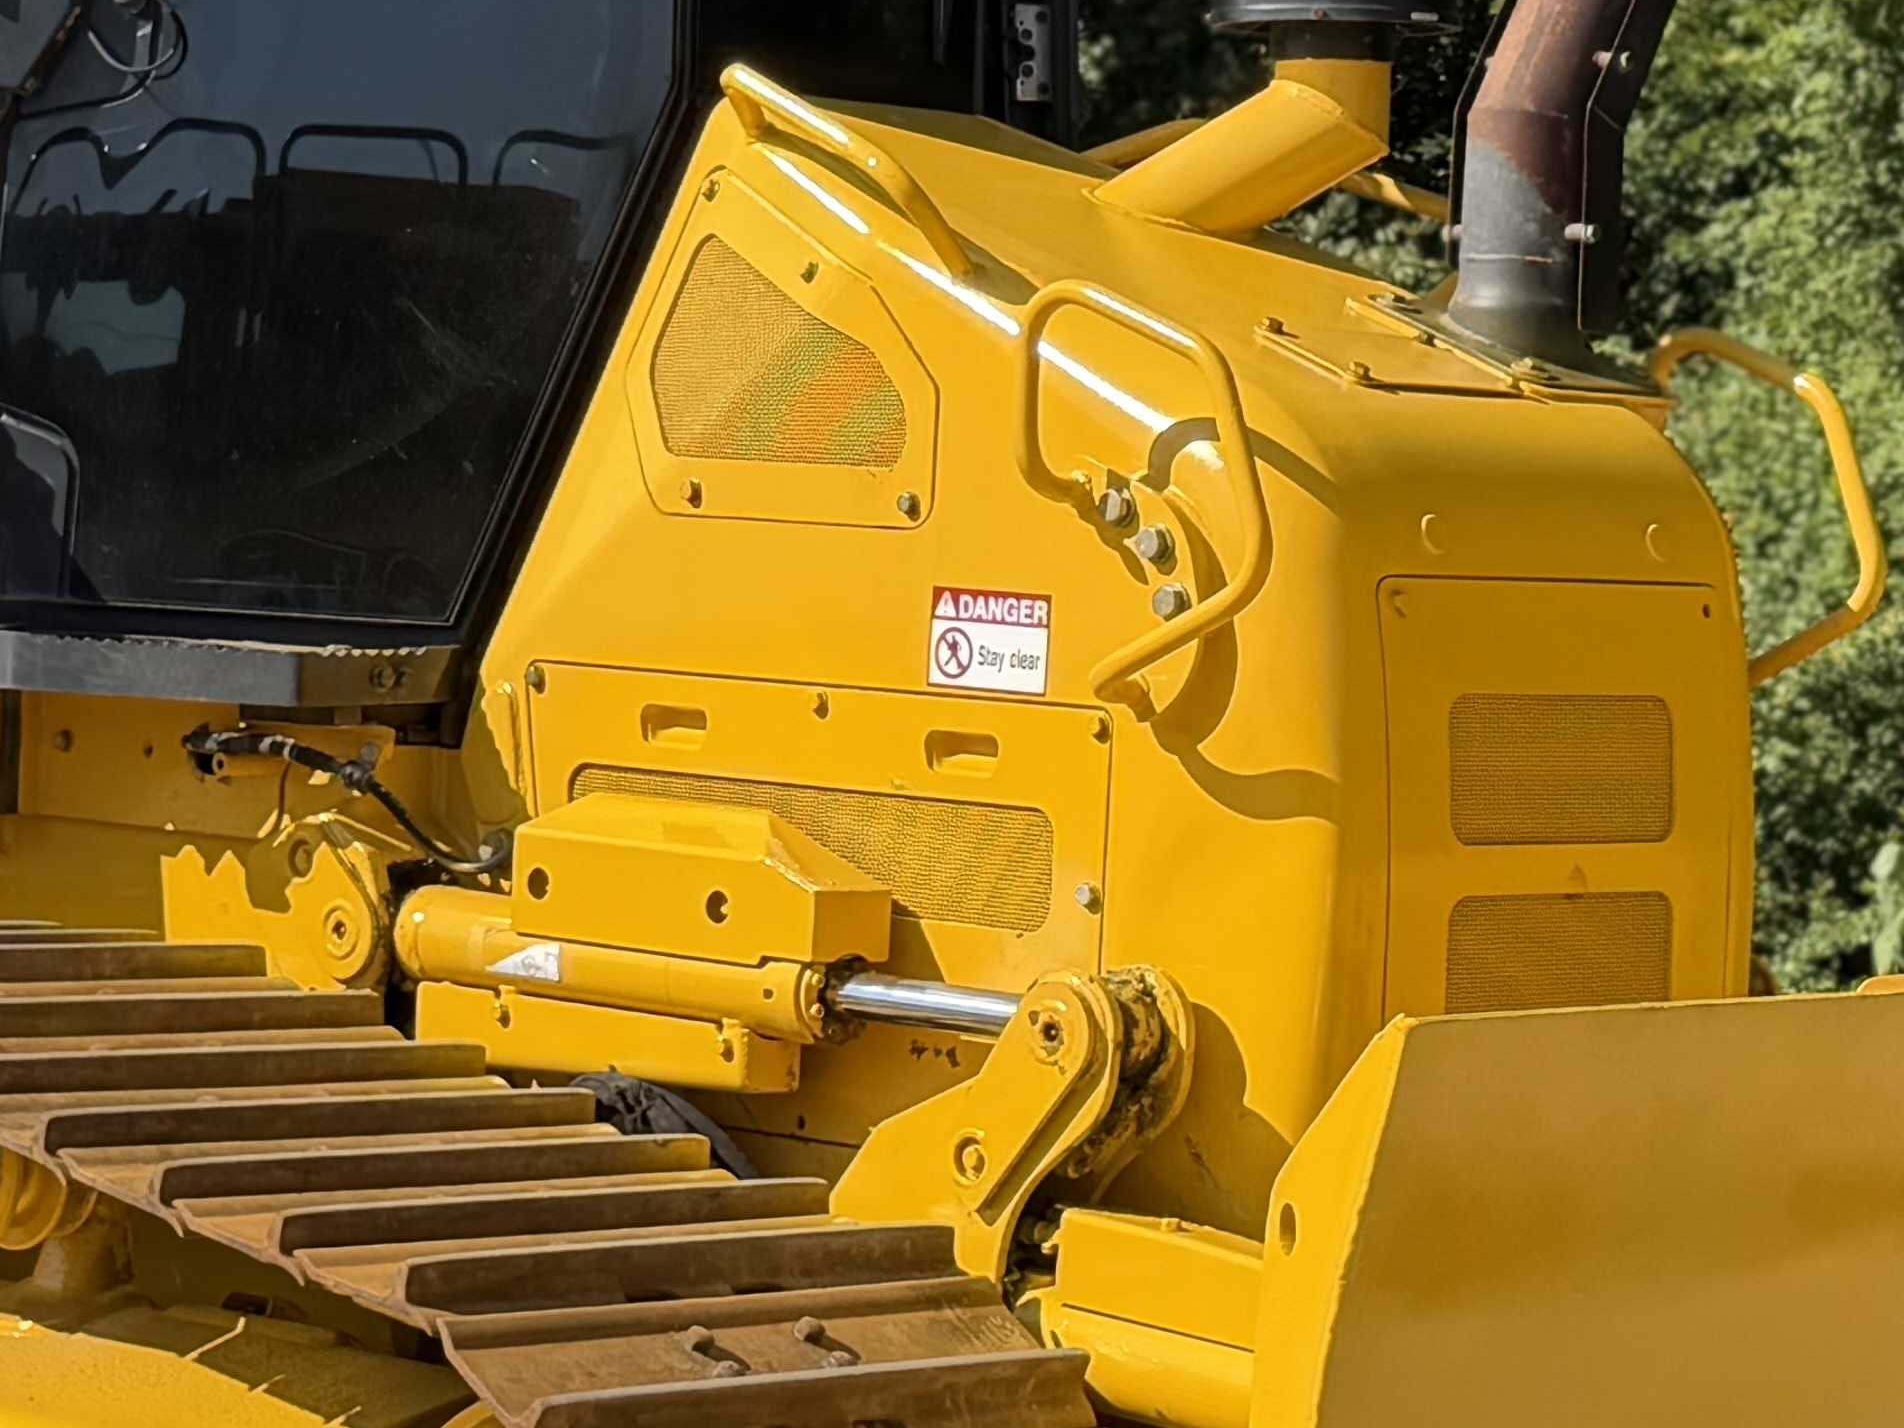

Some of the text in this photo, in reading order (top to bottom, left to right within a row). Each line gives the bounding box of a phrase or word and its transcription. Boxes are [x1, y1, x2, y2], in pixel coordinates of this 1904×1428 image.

[958, 594, 1048, 625] DANGER
[977, 644, 1040, 673] Stay clear
